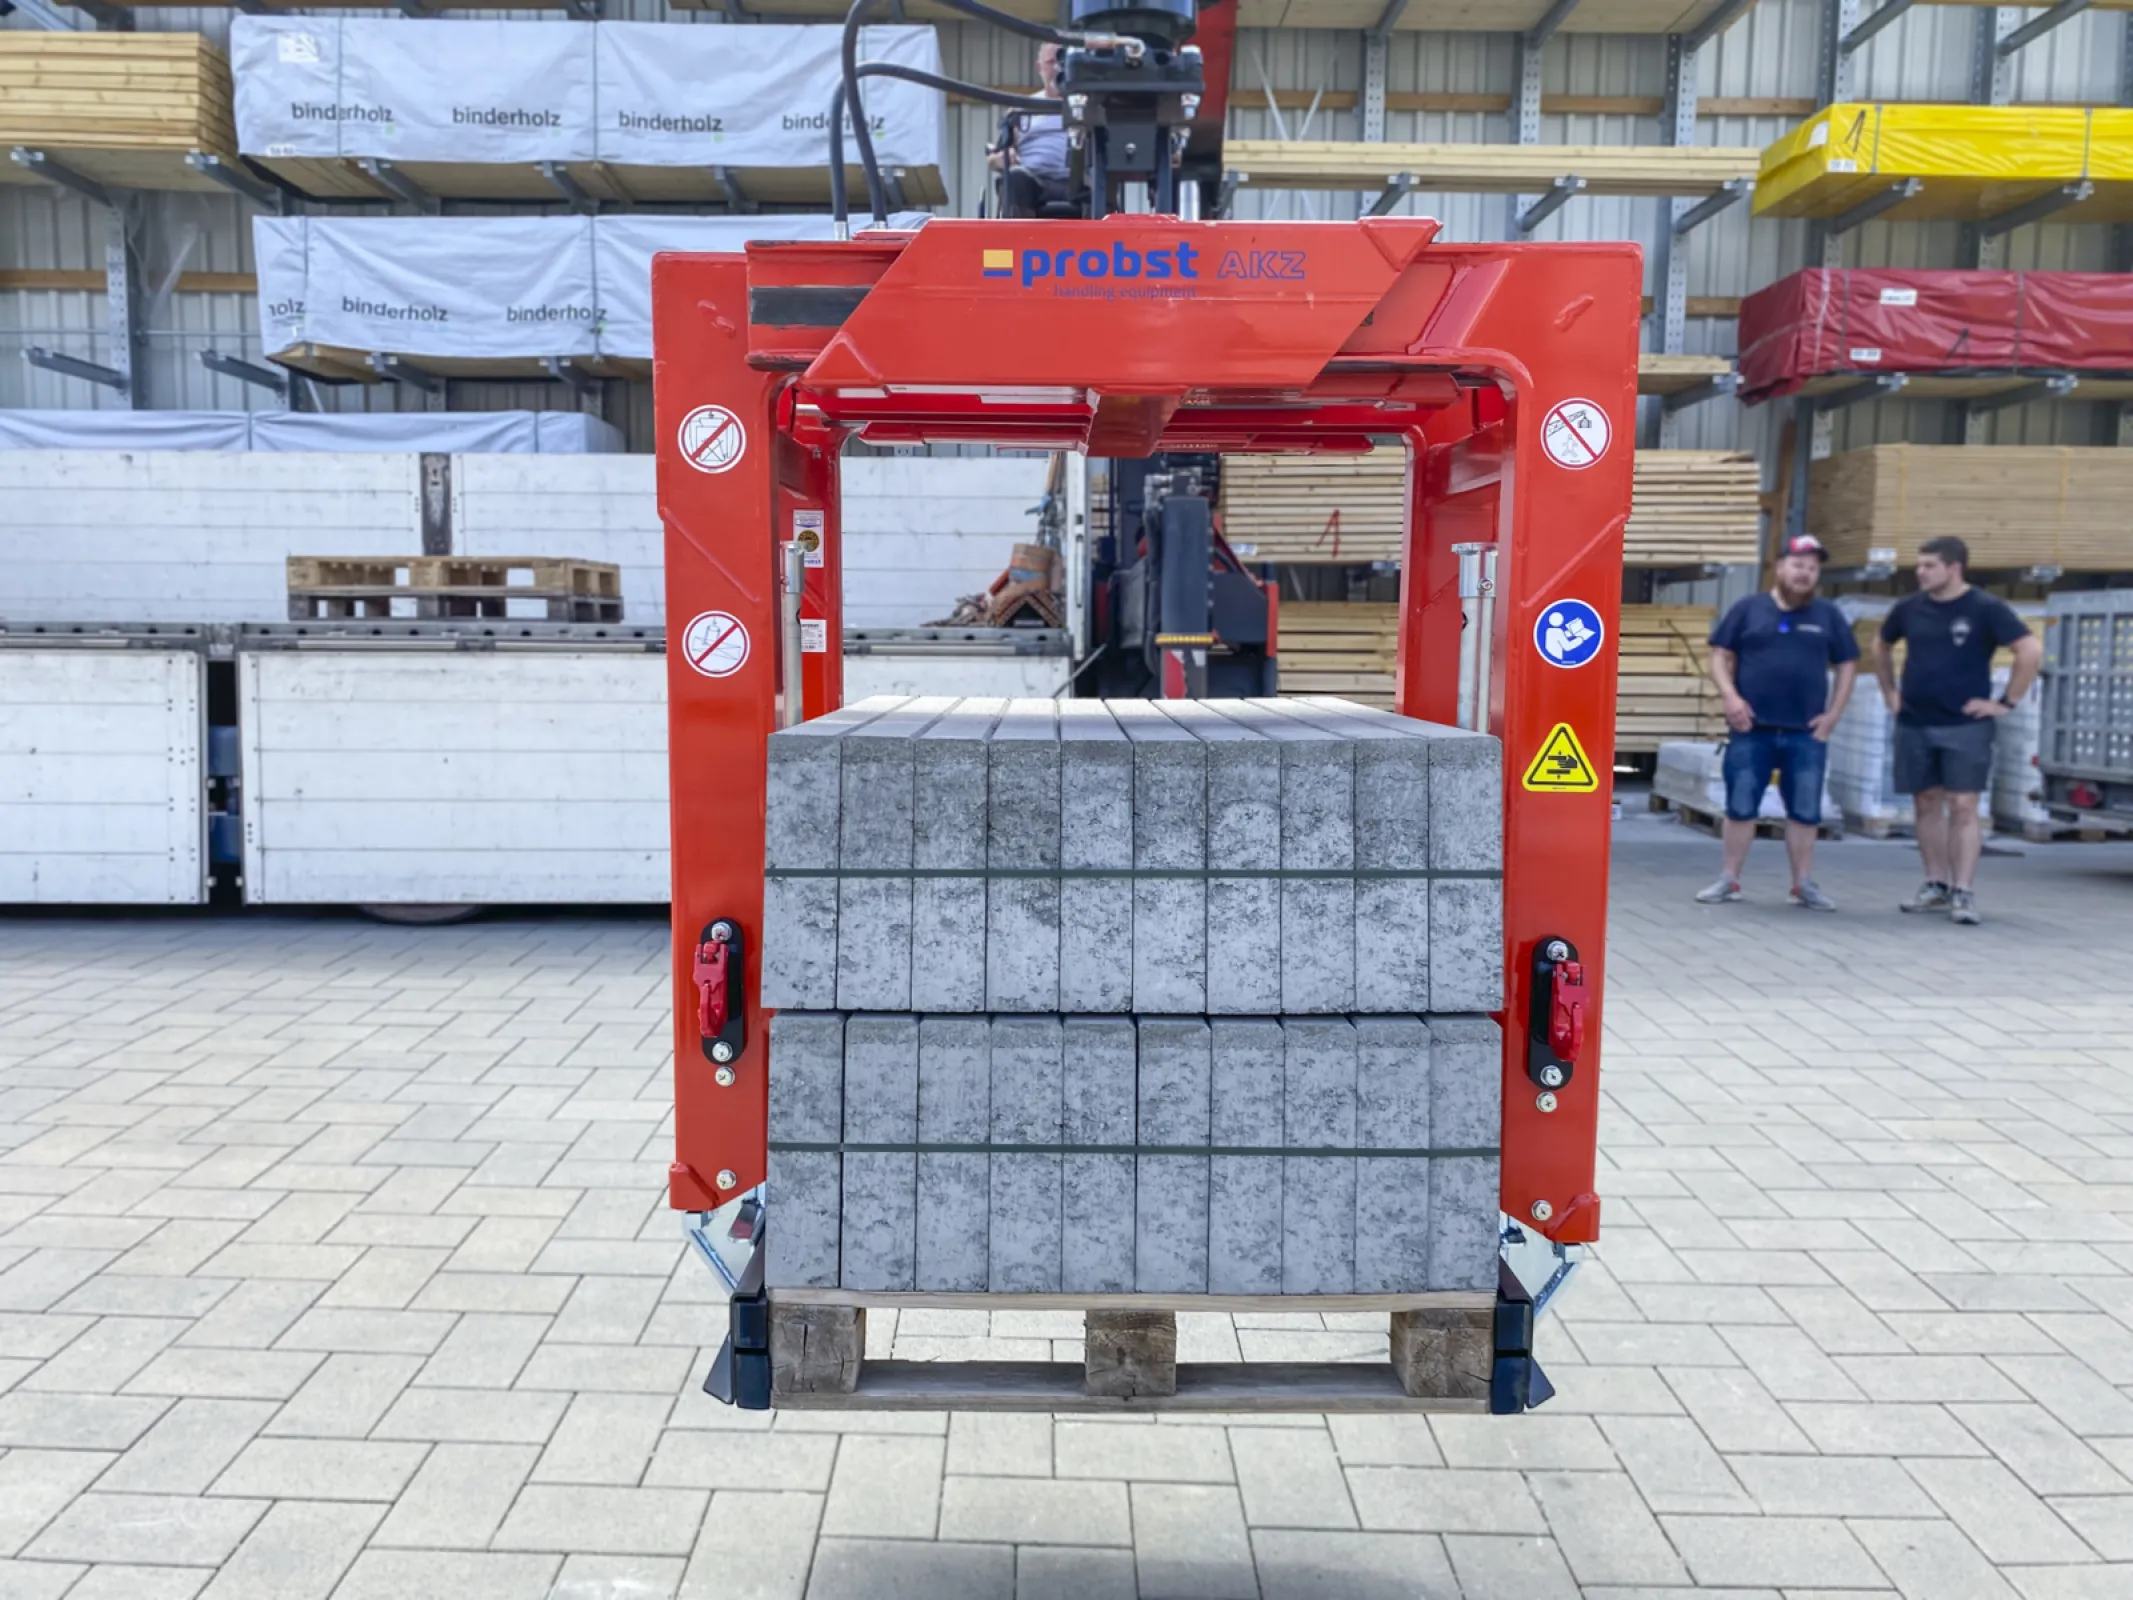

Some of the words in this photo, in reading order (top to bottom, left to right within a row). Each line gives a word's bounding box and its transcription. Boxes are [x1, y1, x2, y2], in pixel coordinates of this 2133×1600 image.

[452, 106, 561, 128] binderholz
[618, 109, 724, 133] binderholz
[1022, 241, 1199, 288] probst
[1217, 250, 1306, 280] AKZ
[1054, 283, 1116, 300] handling
[1120, 285, 1198, 300] equipment
[341, 295, 449, 322] binderholz
